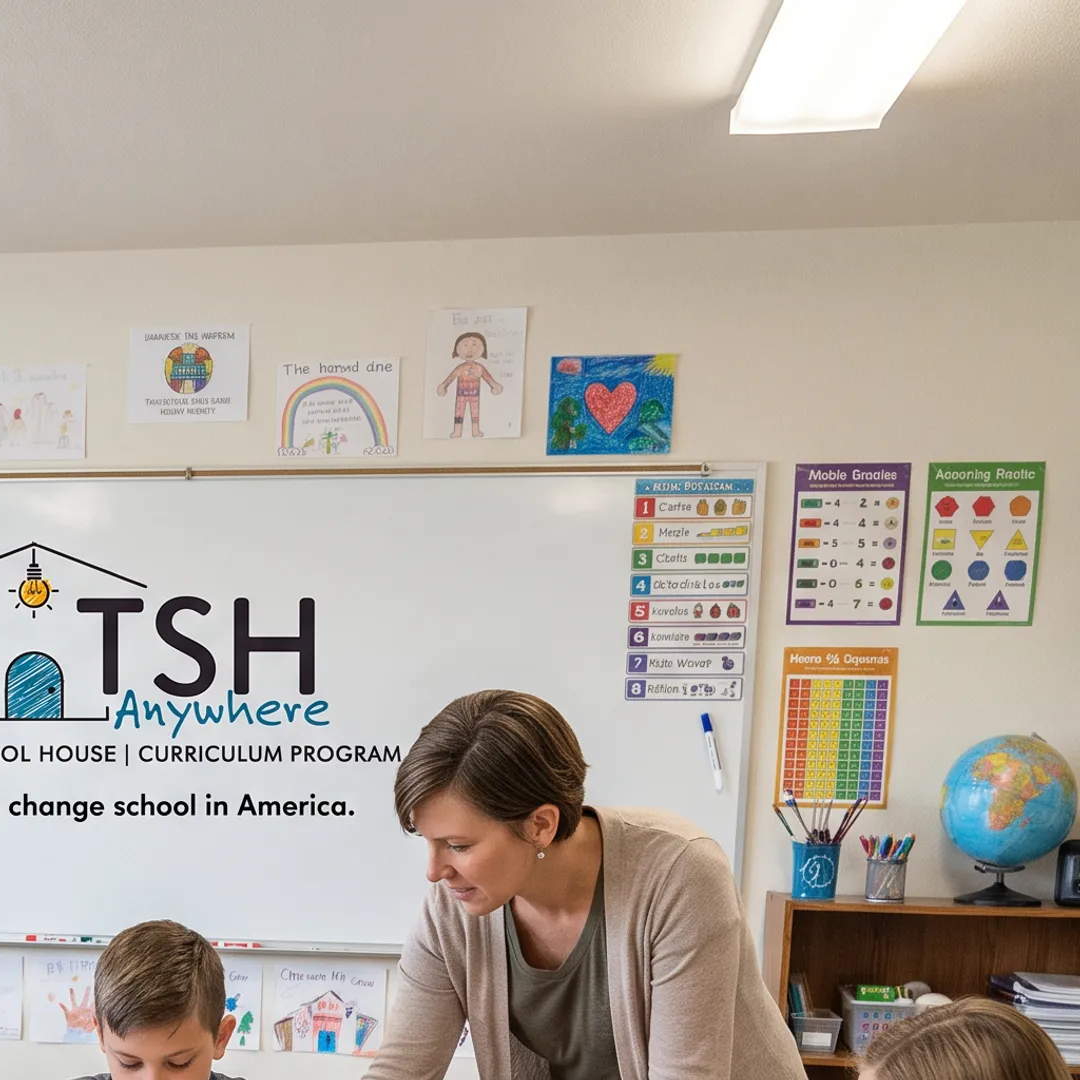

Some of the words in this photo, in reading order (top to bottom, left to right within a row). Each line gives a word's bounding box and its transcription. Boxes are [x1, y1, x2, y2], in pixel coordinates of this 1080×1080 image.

[283, 364, 311, 375] The
[642, 501, 649, 515] 1
[859, 498, 868, 508] 2
[858, 518, 866, 528] 4
[639, 527, 648, 540] 2
[831, 538, 838, 548] 5
[857, 538, 865, 549] 5
[855, 558, 865, 569] 4
[635, 579, 647, 593] 4
[854, 578, 863, 589] 6
[853, 598, 862, 609] 7
[634, 605, 645, 618] 5
[633, 630, 645, 643] 6
[77, 596, 316, 696] TSH
[634, 657, 642, 669] 7
[631, 682, 641, 695] 8
[114, 689, 330, 739] Anywhere
[39, 745, 116, 763] HOUSE
[138, 745, 283, 763] CURRICULUM
[291, 745, 402, 763] PROGRAM
[8, 793, 105, 823] change
[113, 793, 196, 817] school
[205, 793, 228, 817] in
[237, 793, 355, 817] America.
